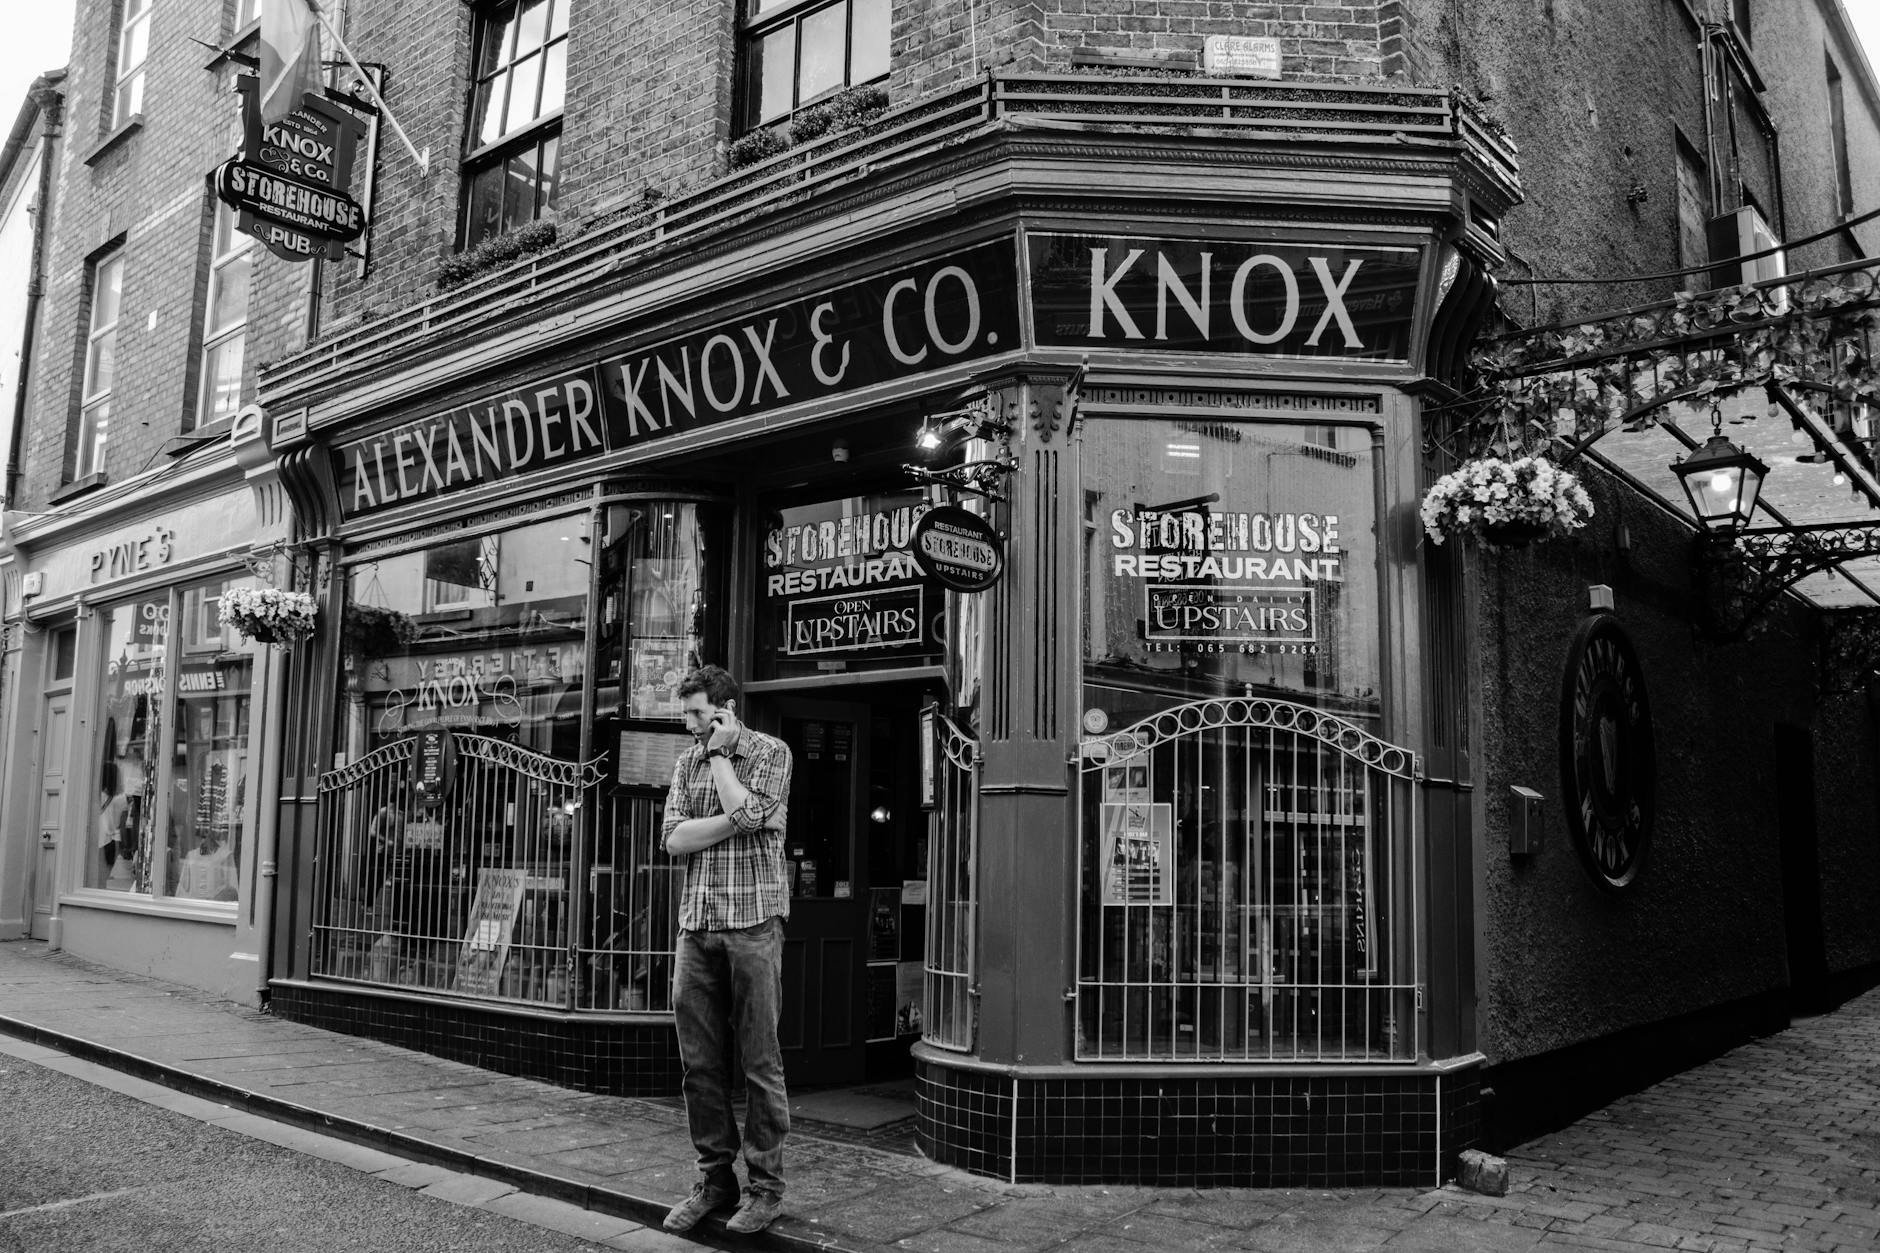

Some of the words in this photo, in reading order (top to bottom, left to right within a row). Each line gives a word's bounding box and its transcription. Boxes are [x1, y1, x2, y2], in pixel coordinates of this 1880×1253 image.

[1214, 41, 1241, 51] CLARE
[1243, 41, 1276, 53] ALARMS
[263, 126, 334, 166] KNOX
[290, 158, 301, 175] &
[304, 163, 330, 182] Co.
[231, 166, 360, 231] STOREHOUSE
[259, 202, 330, 231] RESTAURANT
[270, 226, 311, 254] PUB
[1089, 247, 1365, 349] KNOX
[352, 378, 601, 514] ALEXANDER
[619, 317, 791, 440] KNOX
[810, 301, 852, 387] &
[882, 265, 999, 369] CO.
[767, 503, 933, 568] STOREHOUS
[935, 521, 983, 539] RESTAURANT
[1111, 509, 1340, 553] STOREHOUSE
[91, 527, 176, 584] PYNE'S
[925, 534, 992, 566] STOREHOUSE
[767, 556, 927, 597] RESTAURAN
[936, 563, 984, 580] UPSTAIRS
[1114, 554, 1340, 581] RESTAURANT
[834, 599, 871, 615] OPEN
[1153, 594, 1214, 603] OPEN
[1236, 595, 1306, 604] DAILY
[795, 607, 917, 644] UPSTAIRS
[1153, 605, 1308, 632] UPSTAIRS
[1146, 642, 1181, 652] TEL:
[1197, 643, 1225, 653] 065
[1239, 644, 1266, 654] 682
[1279, 644, 1317, 655] 9264
[417, 674, 480, 712] KNOX
